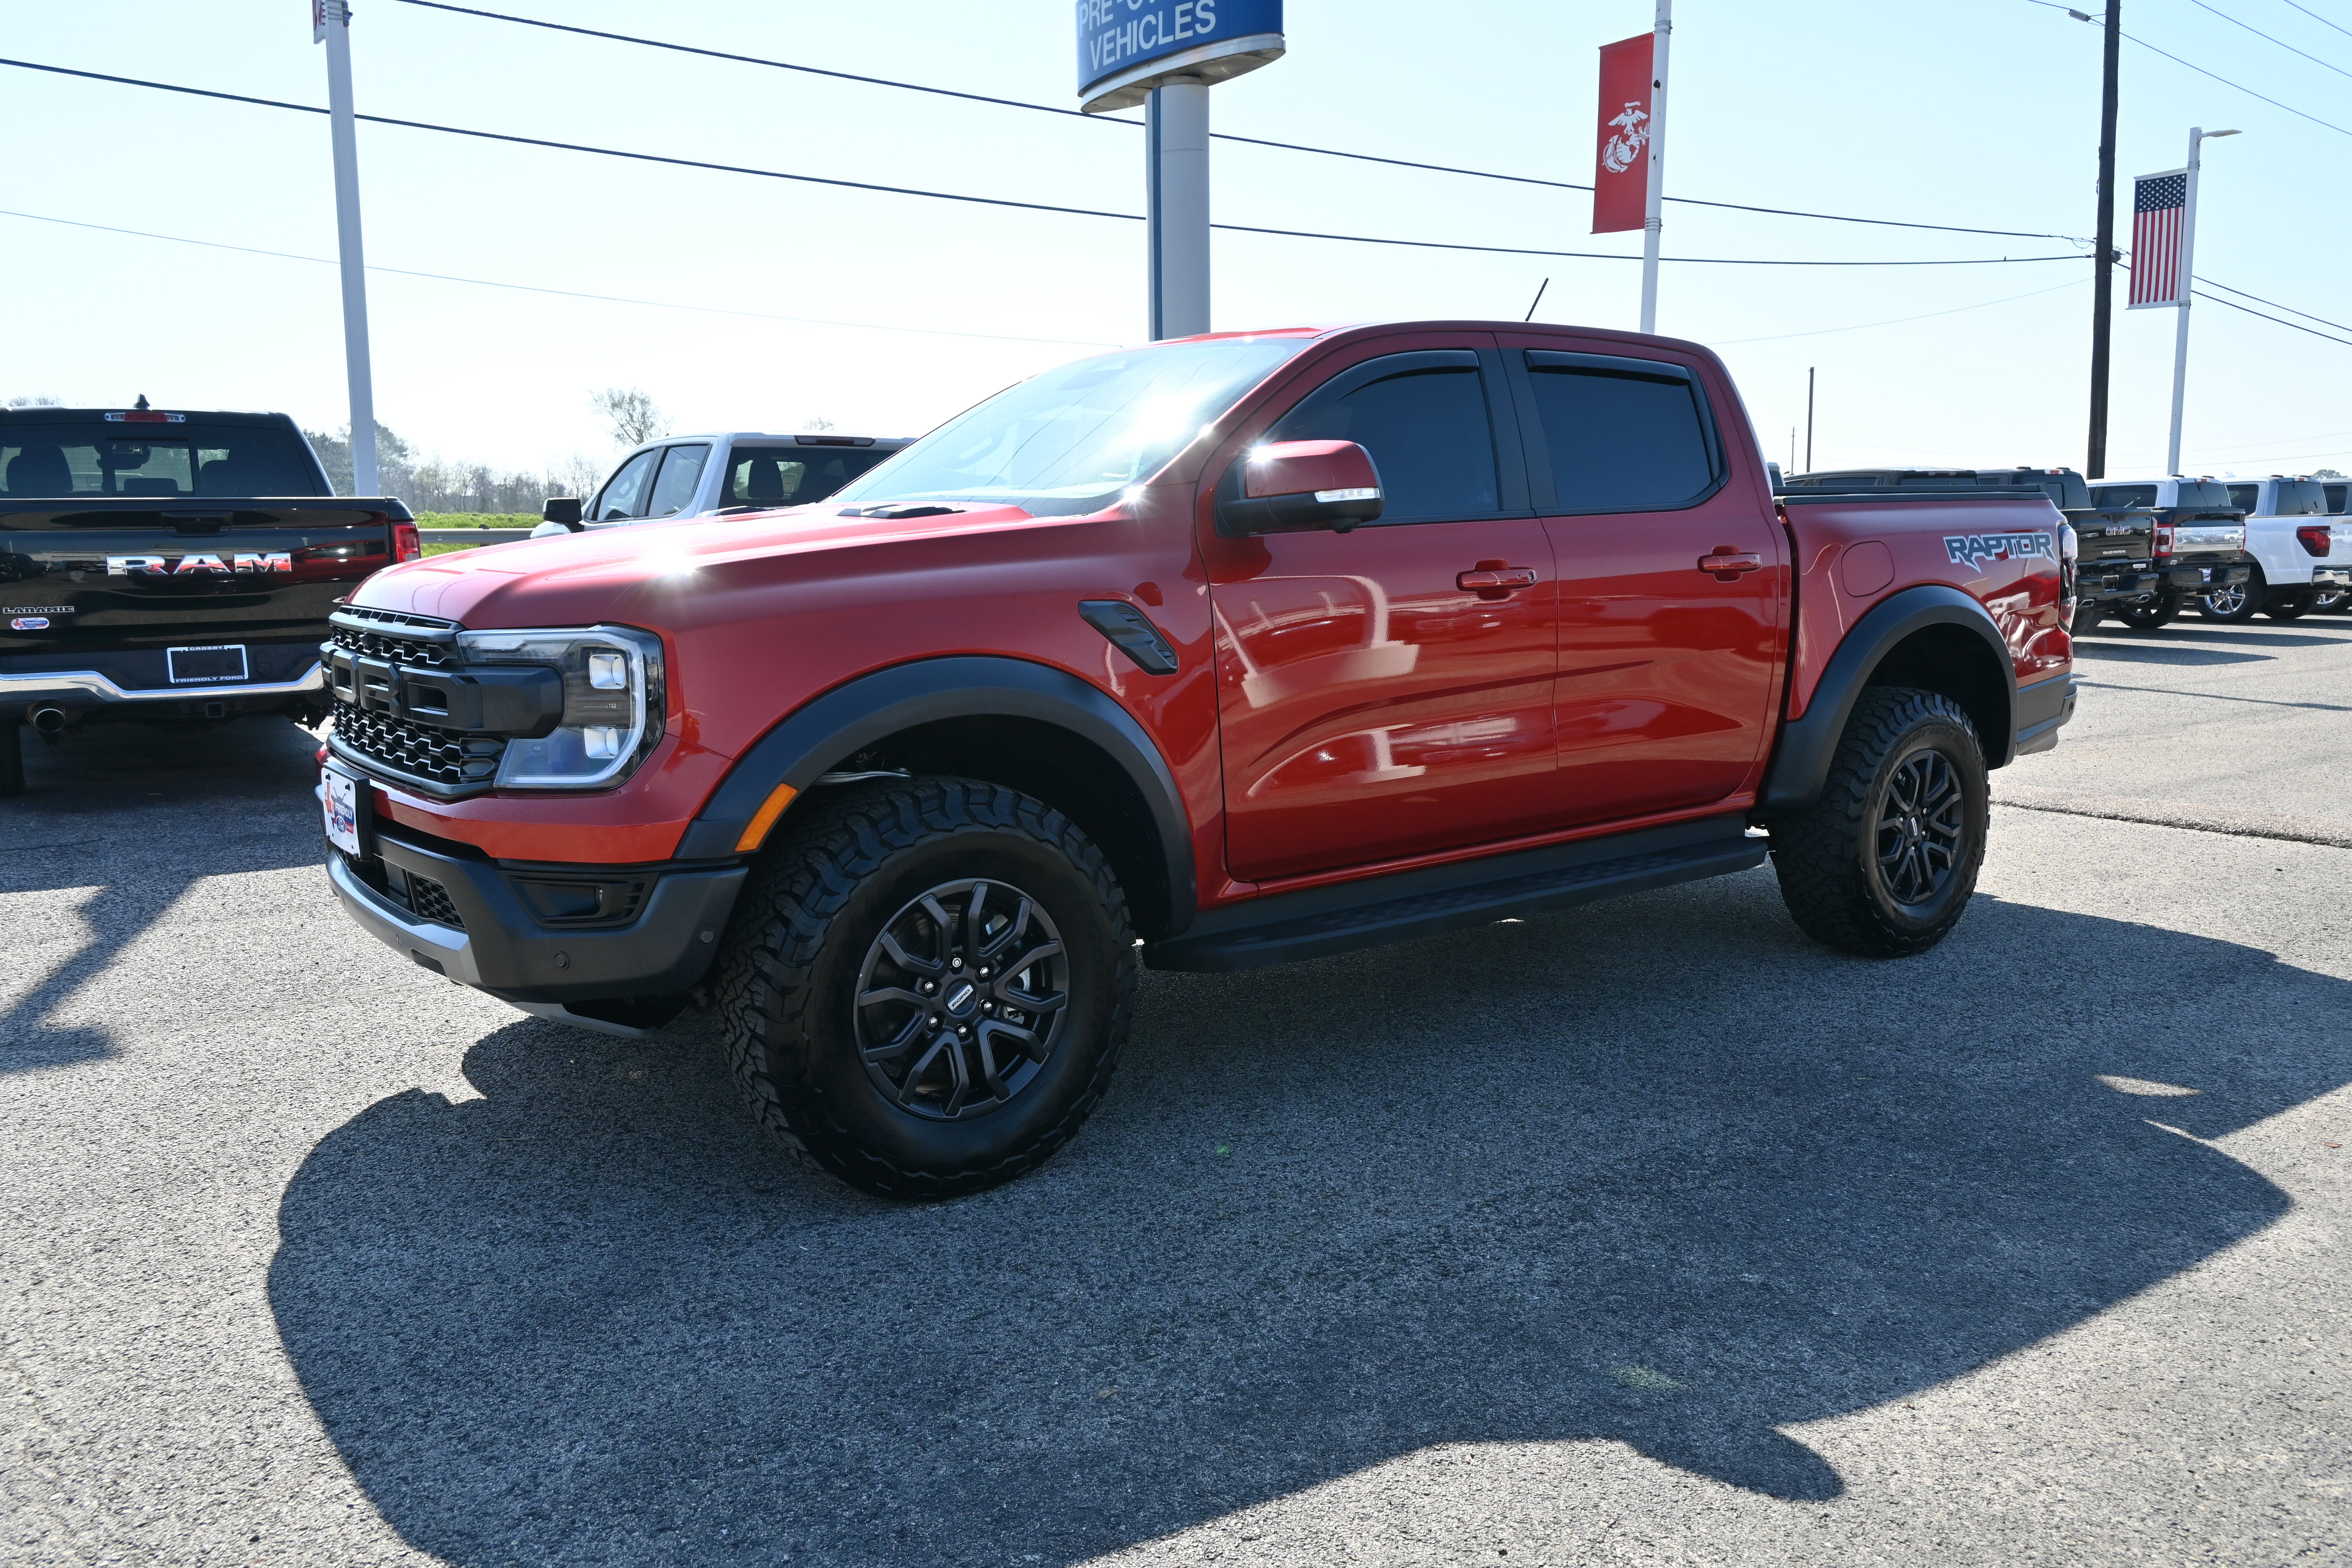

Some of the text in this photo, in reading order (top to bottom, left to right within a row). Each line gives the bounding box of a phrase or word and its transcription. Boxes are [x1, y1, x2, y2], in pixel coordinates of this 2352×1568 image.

[1079, 0, 1154, 38] PRE-
[1089, 0, 1216, 71] VEHICLES
[2106, 526, 2131, 536] GMC
[1943, 532, 2059, 574] RAPTOR
[106, 553, 292, 576] RAM
[3, 606, 74, 614] LARAMIE
[335, 802, 353, 820] FRIENDLY
[952, 989, 970, 1007] FORD
